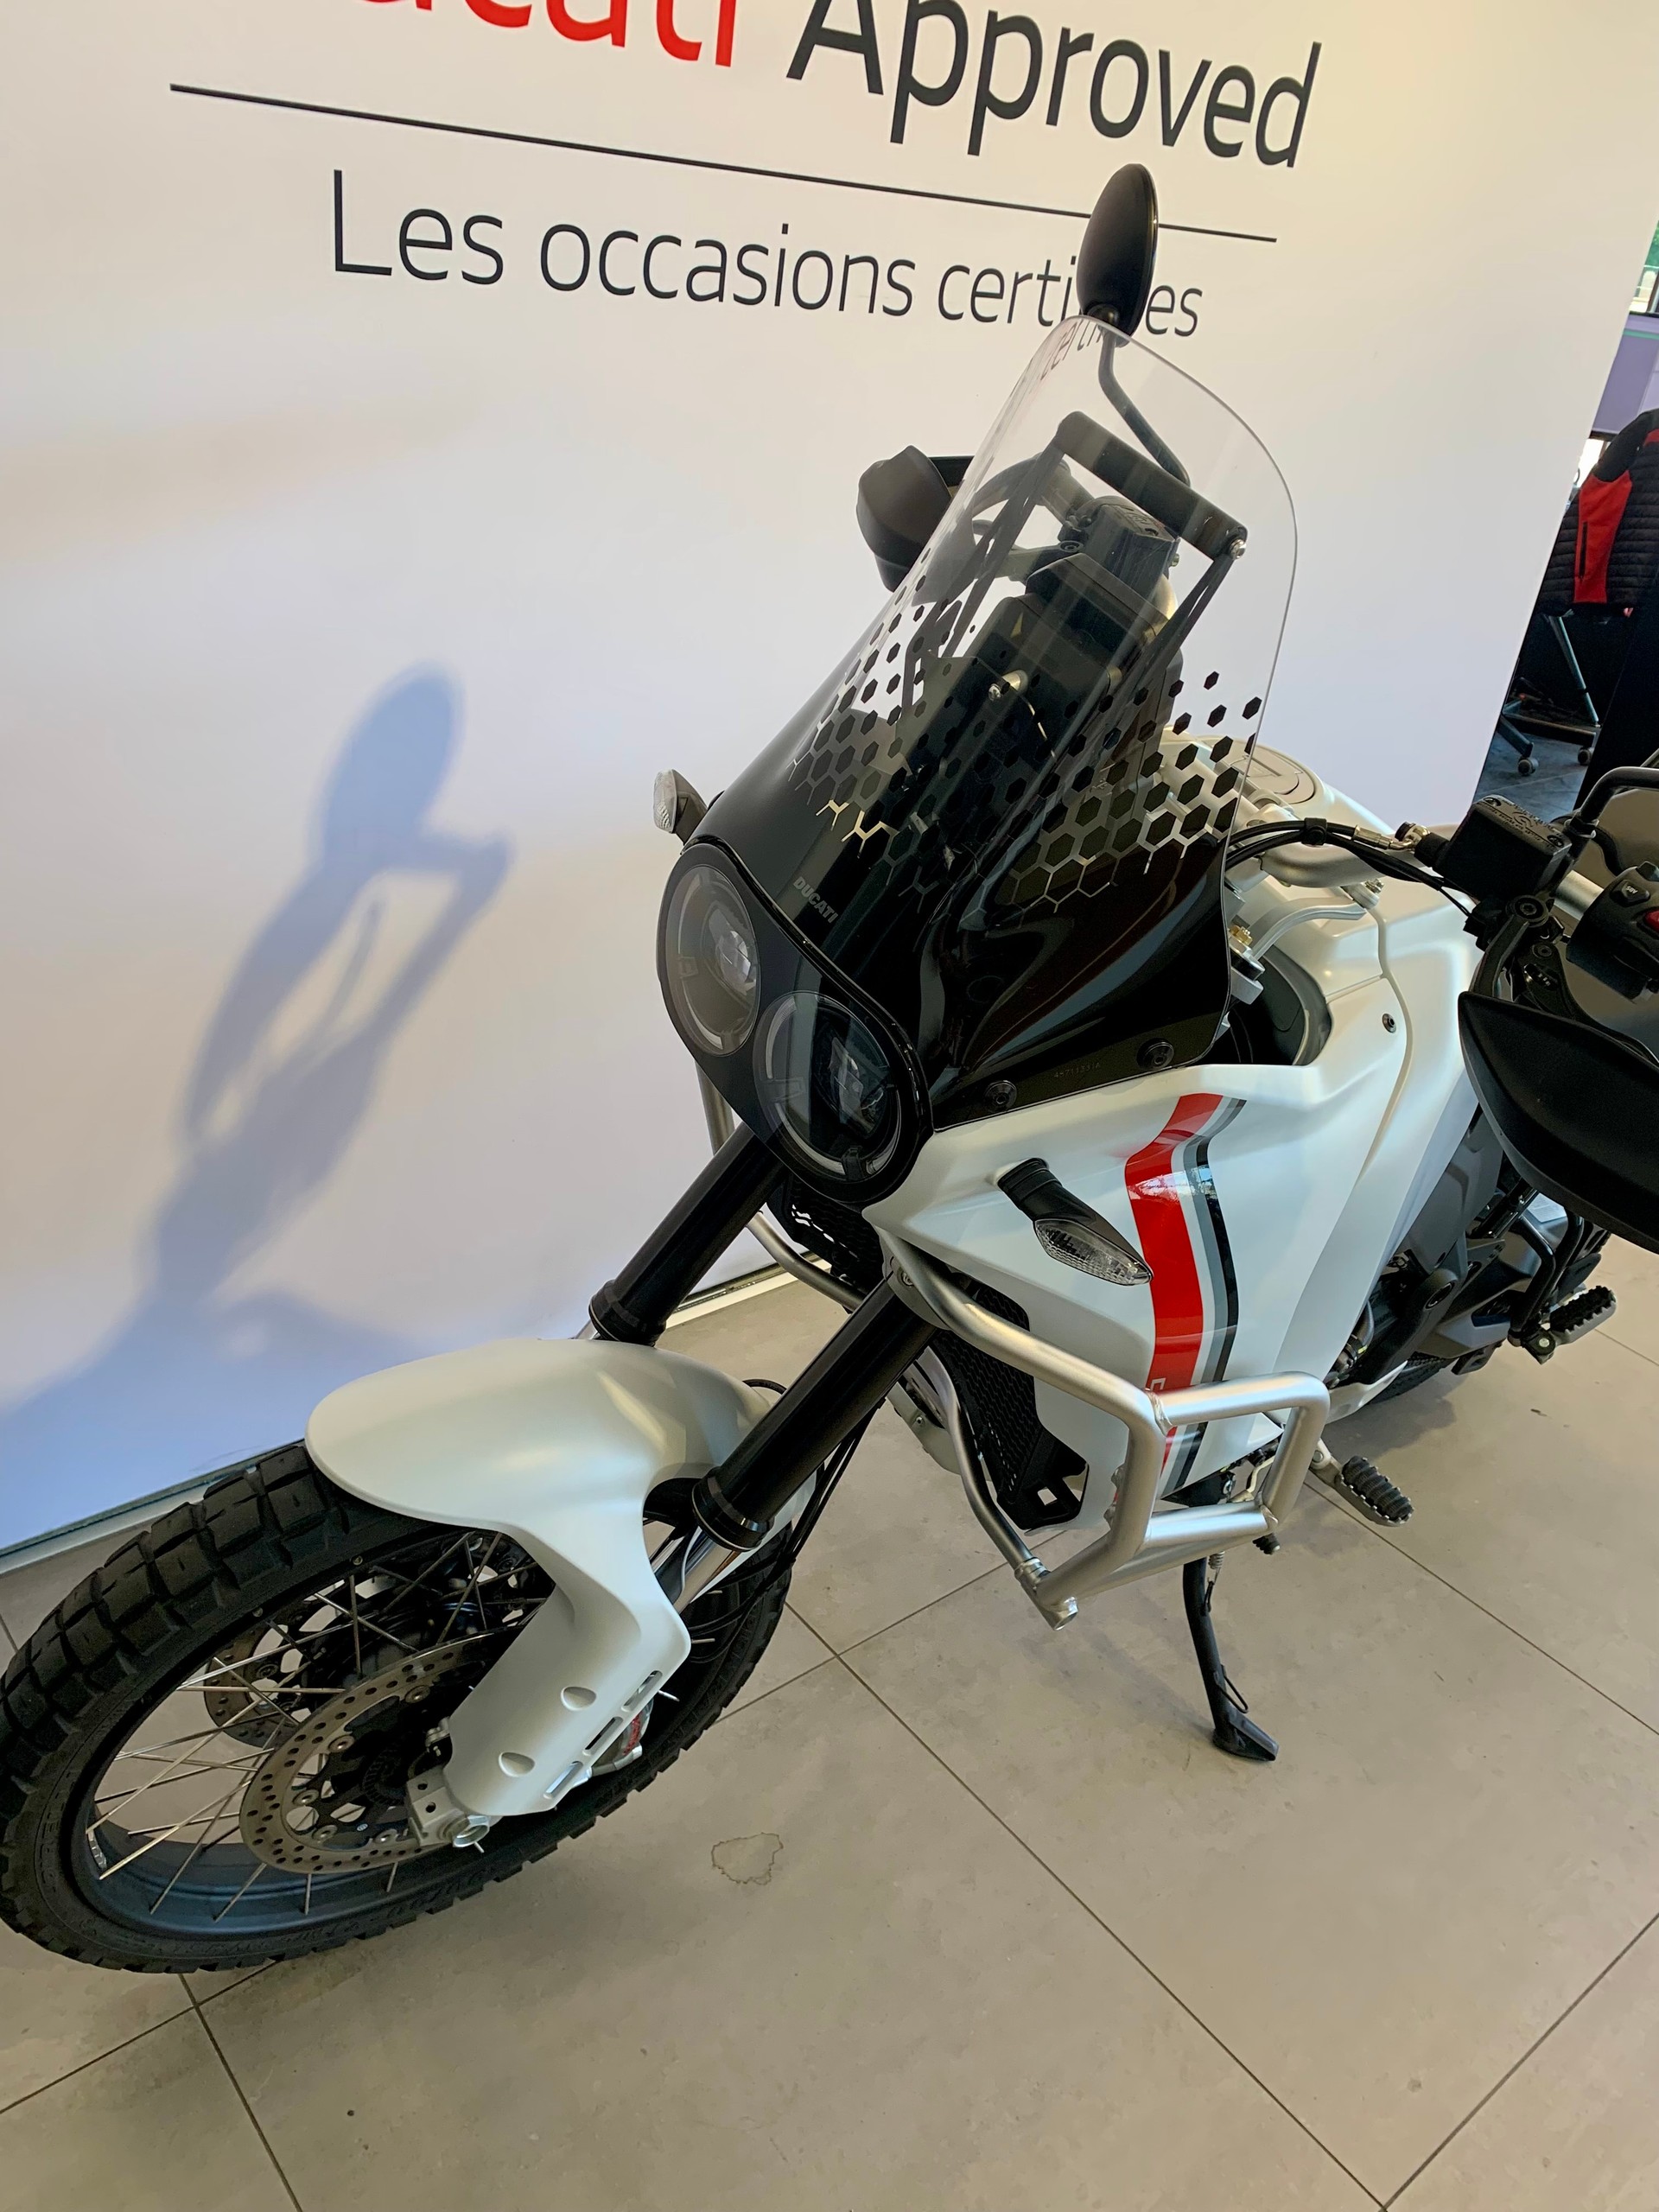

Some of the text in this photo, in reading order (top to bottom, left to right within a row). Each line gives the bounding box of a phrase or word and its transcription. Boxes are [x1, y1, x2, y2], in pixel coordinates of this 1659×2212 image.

[786, 0, 1322, 168] Approved
[334, 169, 1203, 337] Les occasions certies
[793, 876, 838, 924] DUCATI
